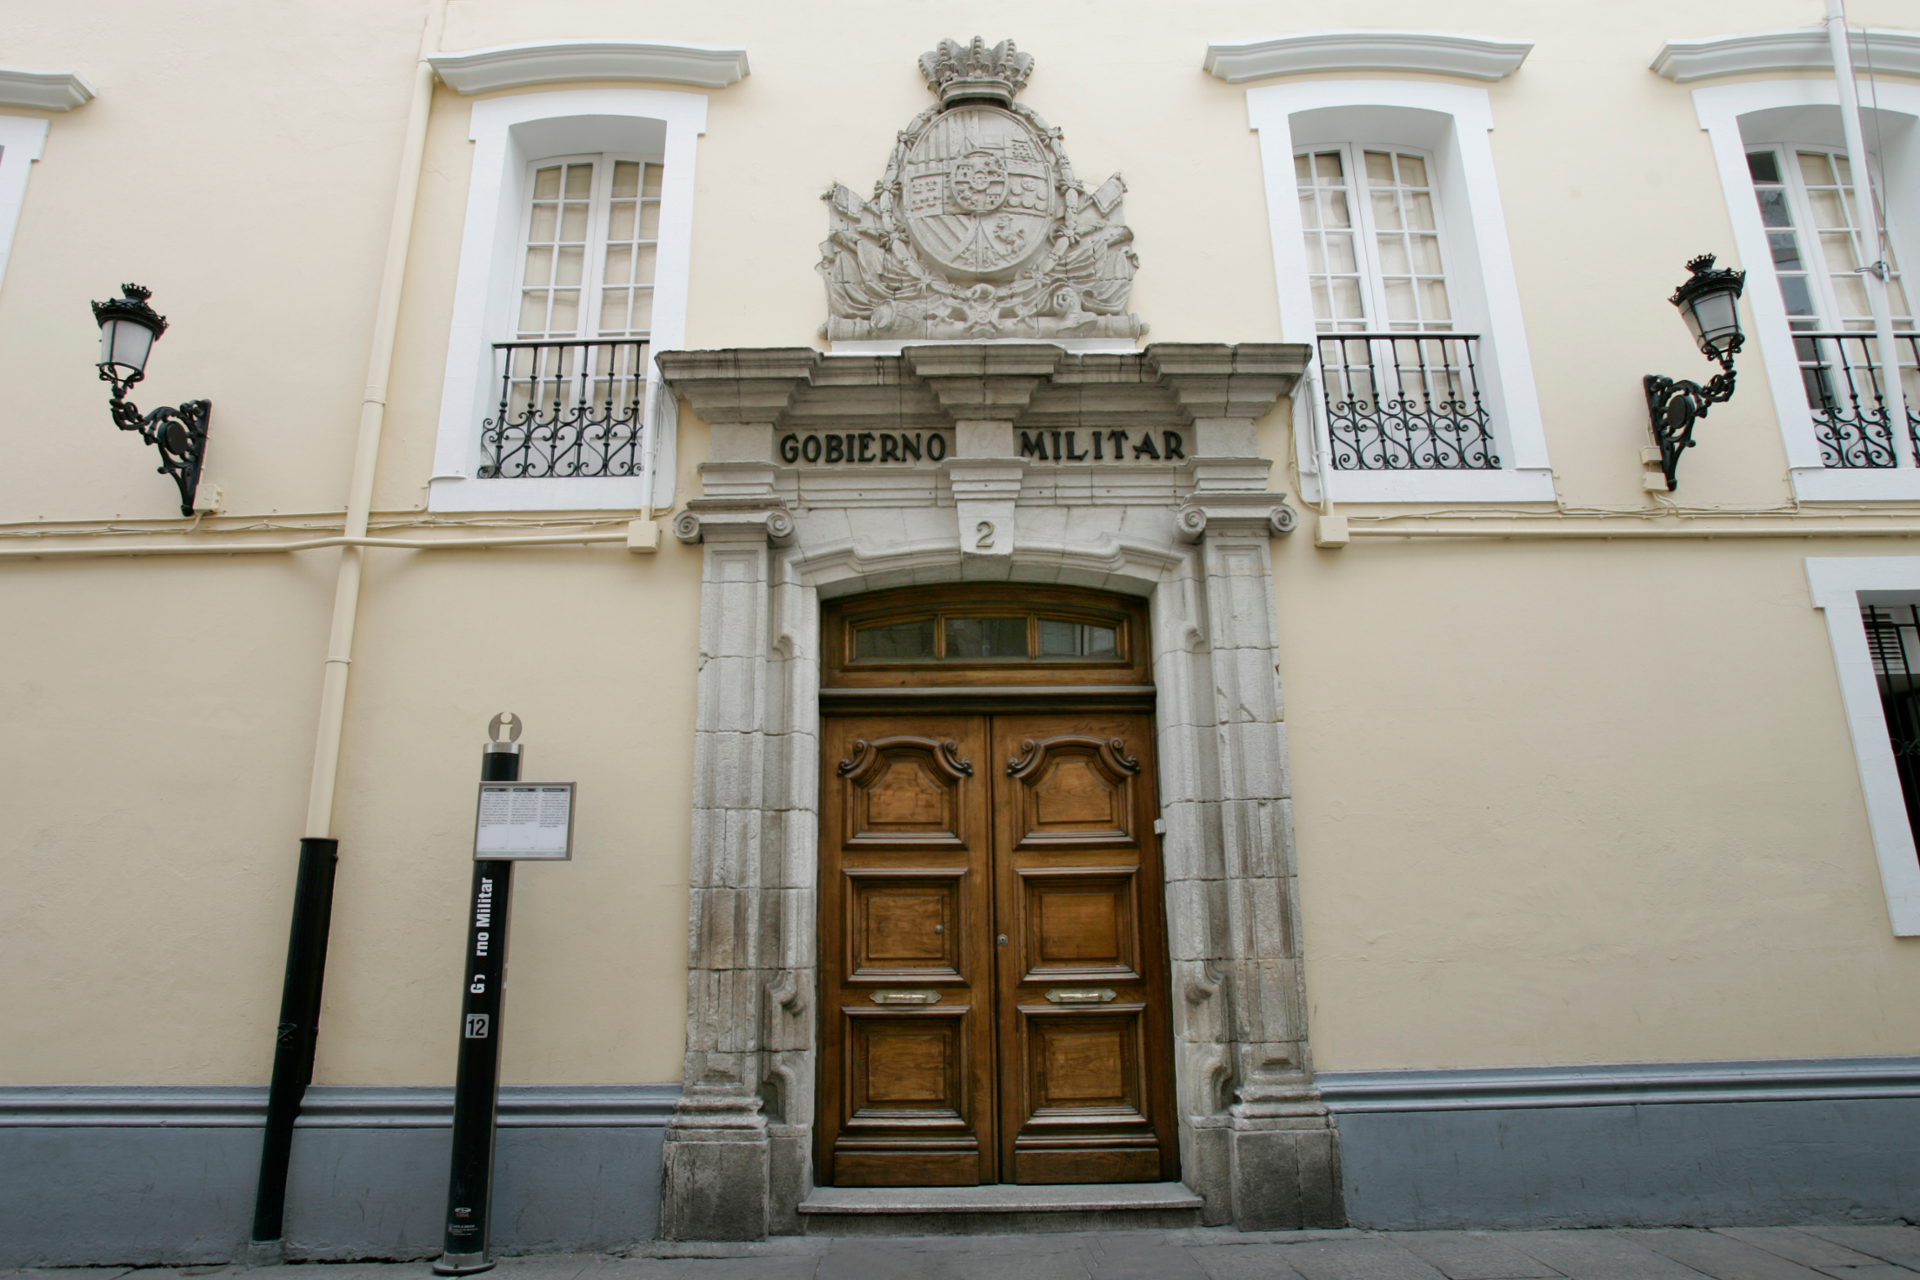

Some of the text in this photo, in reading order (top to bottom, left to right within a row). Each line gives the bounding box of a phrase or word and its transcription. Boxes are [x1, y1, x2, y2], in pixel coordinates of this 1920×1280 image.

[780, 430, 1185, 463] GOBIERNO MILITAR
[976, 520, 995, 548] 2
[475, 877, 493, 928] Militar
[468, 1018, 486, 1036] 12
